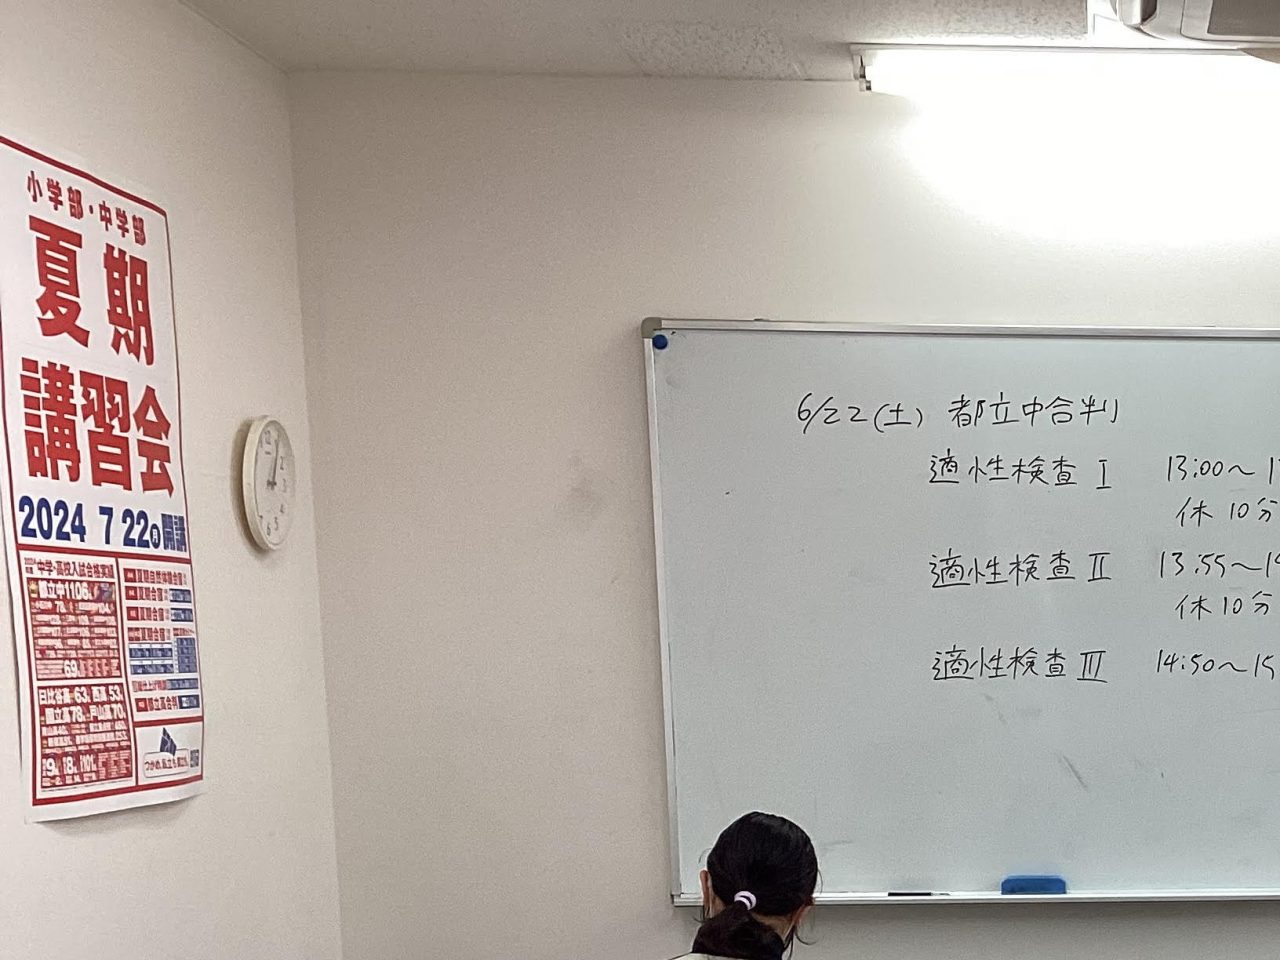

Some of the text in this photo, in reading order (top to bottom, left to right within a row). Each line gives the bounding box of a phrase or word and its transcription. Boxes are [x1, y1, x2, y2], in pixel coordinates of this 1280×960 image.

[26, 170, 147, 247] 小学部・中学部
[28, 214, 155, 367] 夏期
[19, 356, 175, 499] 講習会
[18, 495, 87, 543] 2024
[98, 505, 114, 545] 7
